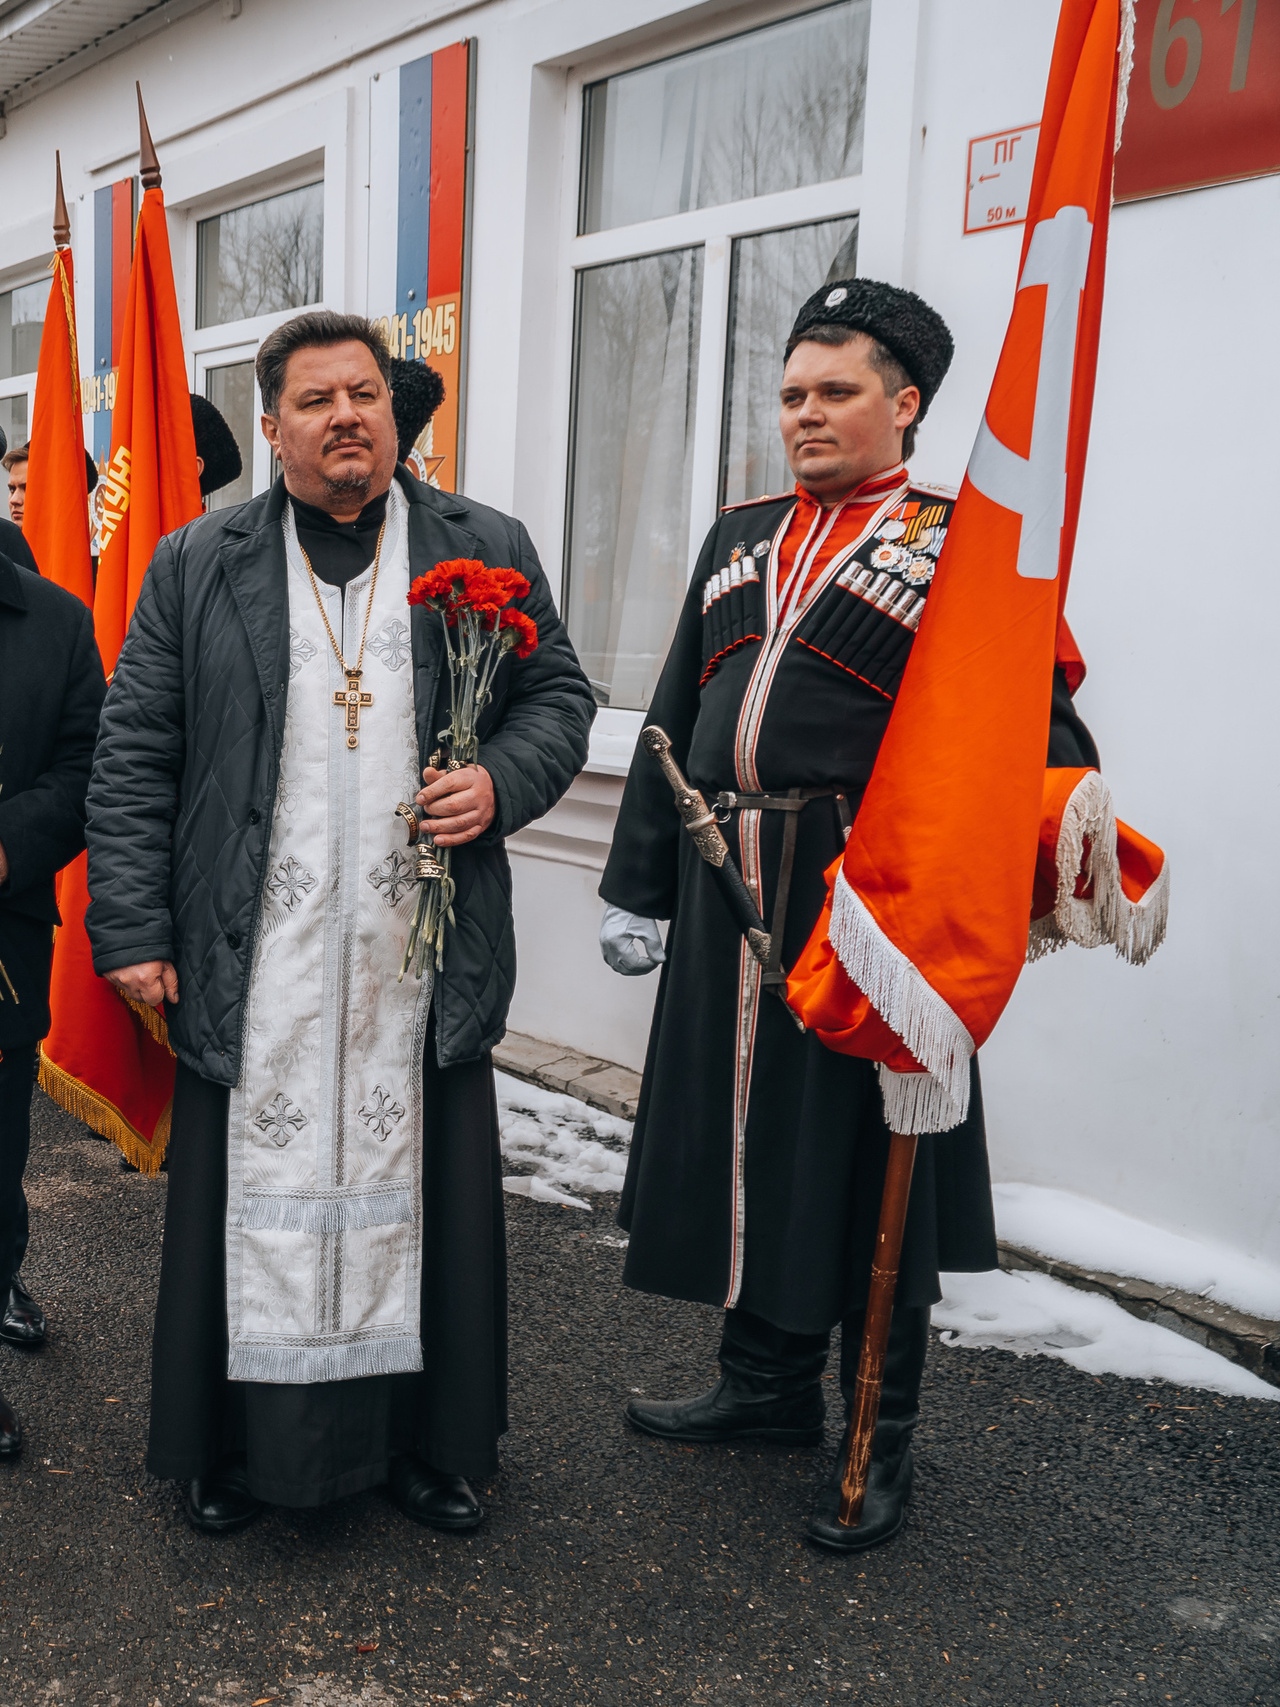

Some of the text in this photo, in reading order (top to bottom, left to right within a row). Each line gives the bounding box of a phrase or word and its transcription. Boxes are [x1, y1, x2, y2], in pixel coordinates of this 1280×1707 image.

[1150, 0, 1258, 110] 61
[993, 136, 1022, 166] ПГ
[987, 205, 1003, 222] 50
[80, 371, 118, 414] 1941-19
